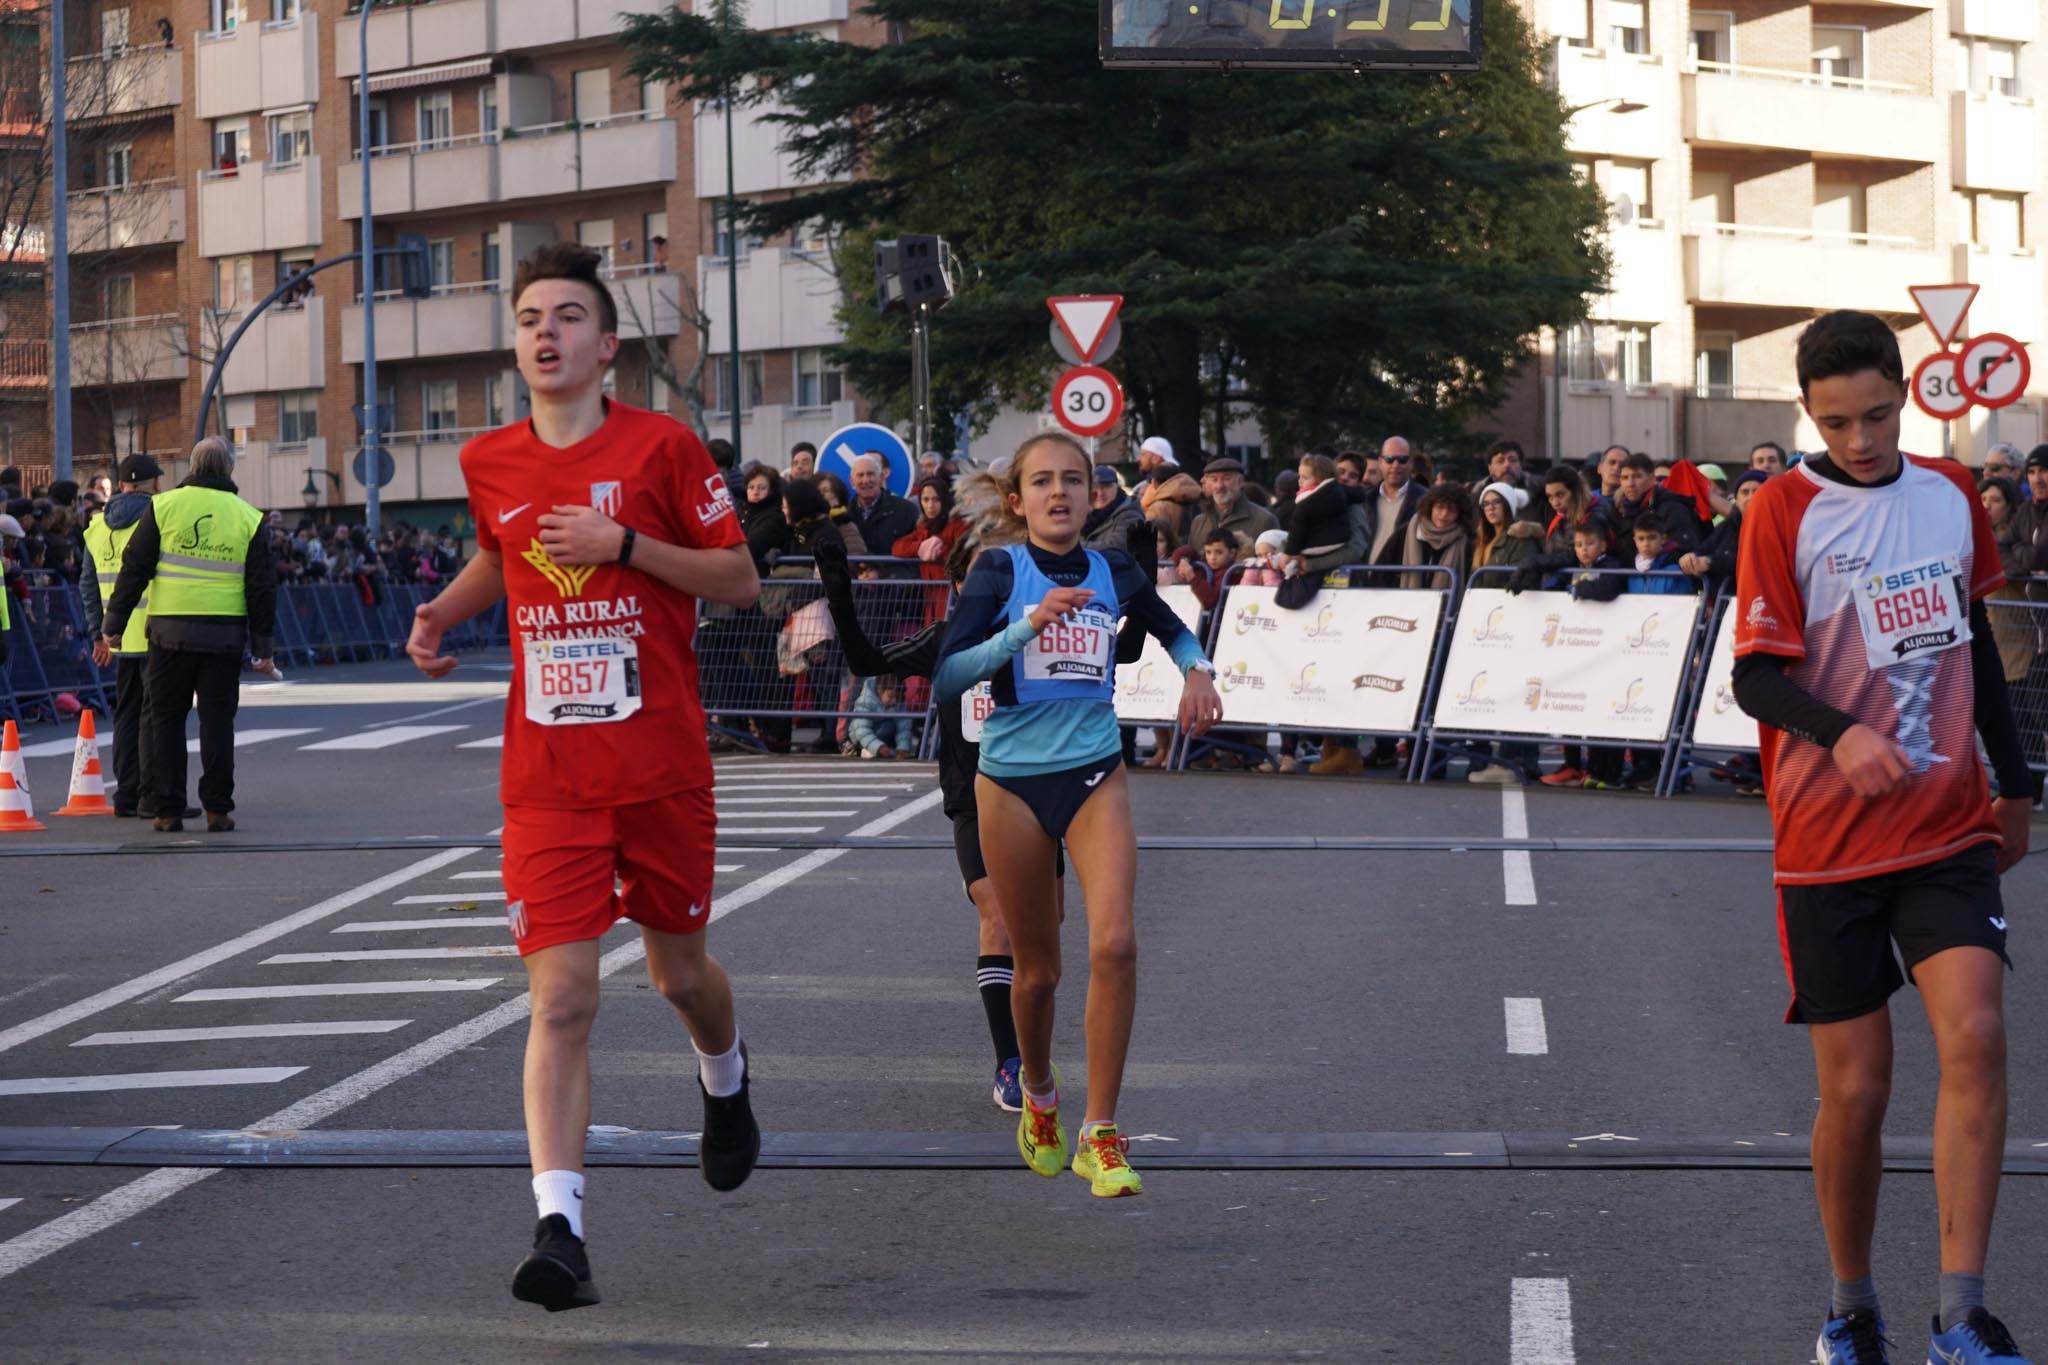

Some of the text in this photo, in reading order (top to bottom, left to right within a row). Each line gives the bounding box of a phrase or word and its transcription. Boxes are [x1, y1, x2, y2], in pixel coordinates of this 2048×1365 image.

[1069, 391, 1105, 412] 30
[1885, 560, 1952, 590] SETEL
[516, 596, 643, 630] CAJA RURAL
[1874, 582, 1947, 634] 6694
[1243, 616, 1278, 628] SETEL
[1039, 623, 1099, 655] 6687
[1904, 633, 1949, 651] ALJOMAR
[552, 643, 625, 659] SETEL
[541, 660, 608, 695] 6857
[1056, 662, 1097, 675] ALJOMAR
[1230, 674, 1265, 686] SETEL
[560, 704, 606, 718] ALJOMAR
